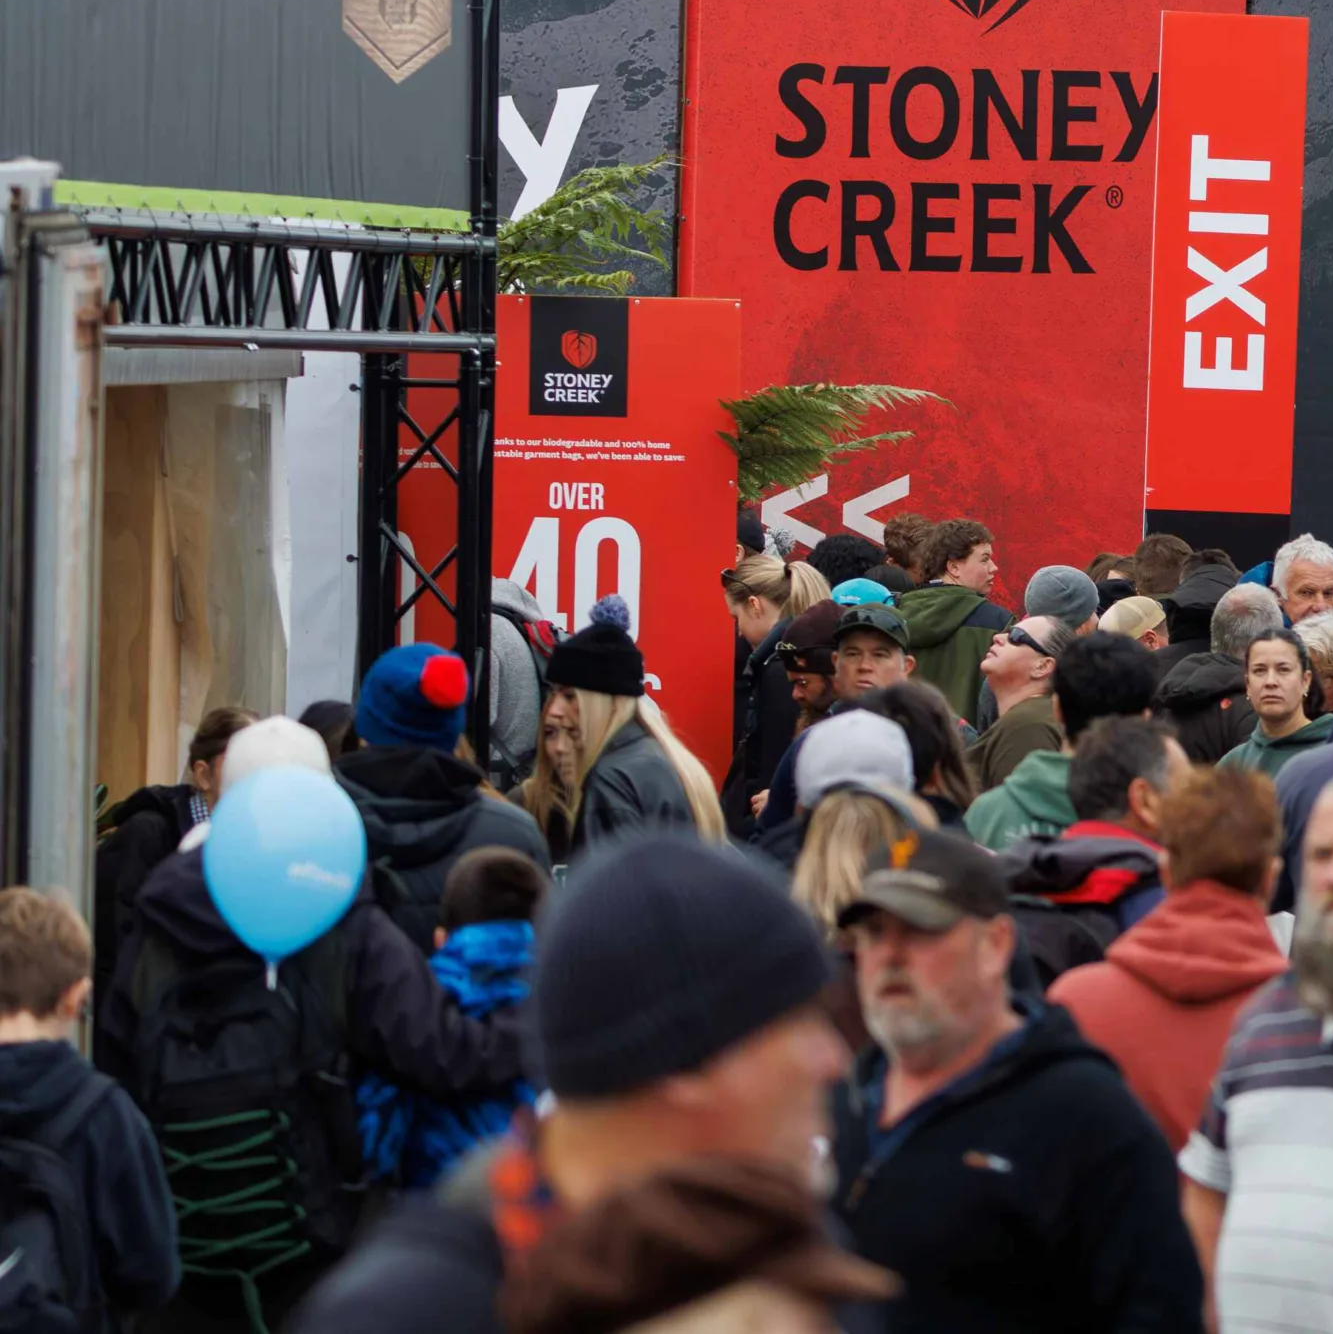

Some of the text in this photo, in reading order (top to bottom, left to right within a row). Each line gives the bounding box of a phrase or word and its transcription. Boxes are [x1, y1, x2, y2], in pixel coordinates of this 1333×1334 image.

[775, 63, 1158, 163] STONEY
[1182, 134, 1272, 392] EXIT
[544, 373, 613, 388] STONEY
[494, 439, 514, 447] anks
[516, 439, 525, 447] to
[543, 438, 602, 449] biodegradable
[604, 440, 620, 448] and
[647, 441, 670, 449] home
[524, 452, 560, 461] garment
[562, 451, 584, 461] bags,
[586, 452, 610, 460] we've
[611, 452, 632, 461] been
[633, 453, 651, 461] able
[653, 454, 662, 462] to
[664, 454, 685, 462] save:
[549, 482, 604, 510] OVER
[508, 517, 640, 644] 40
